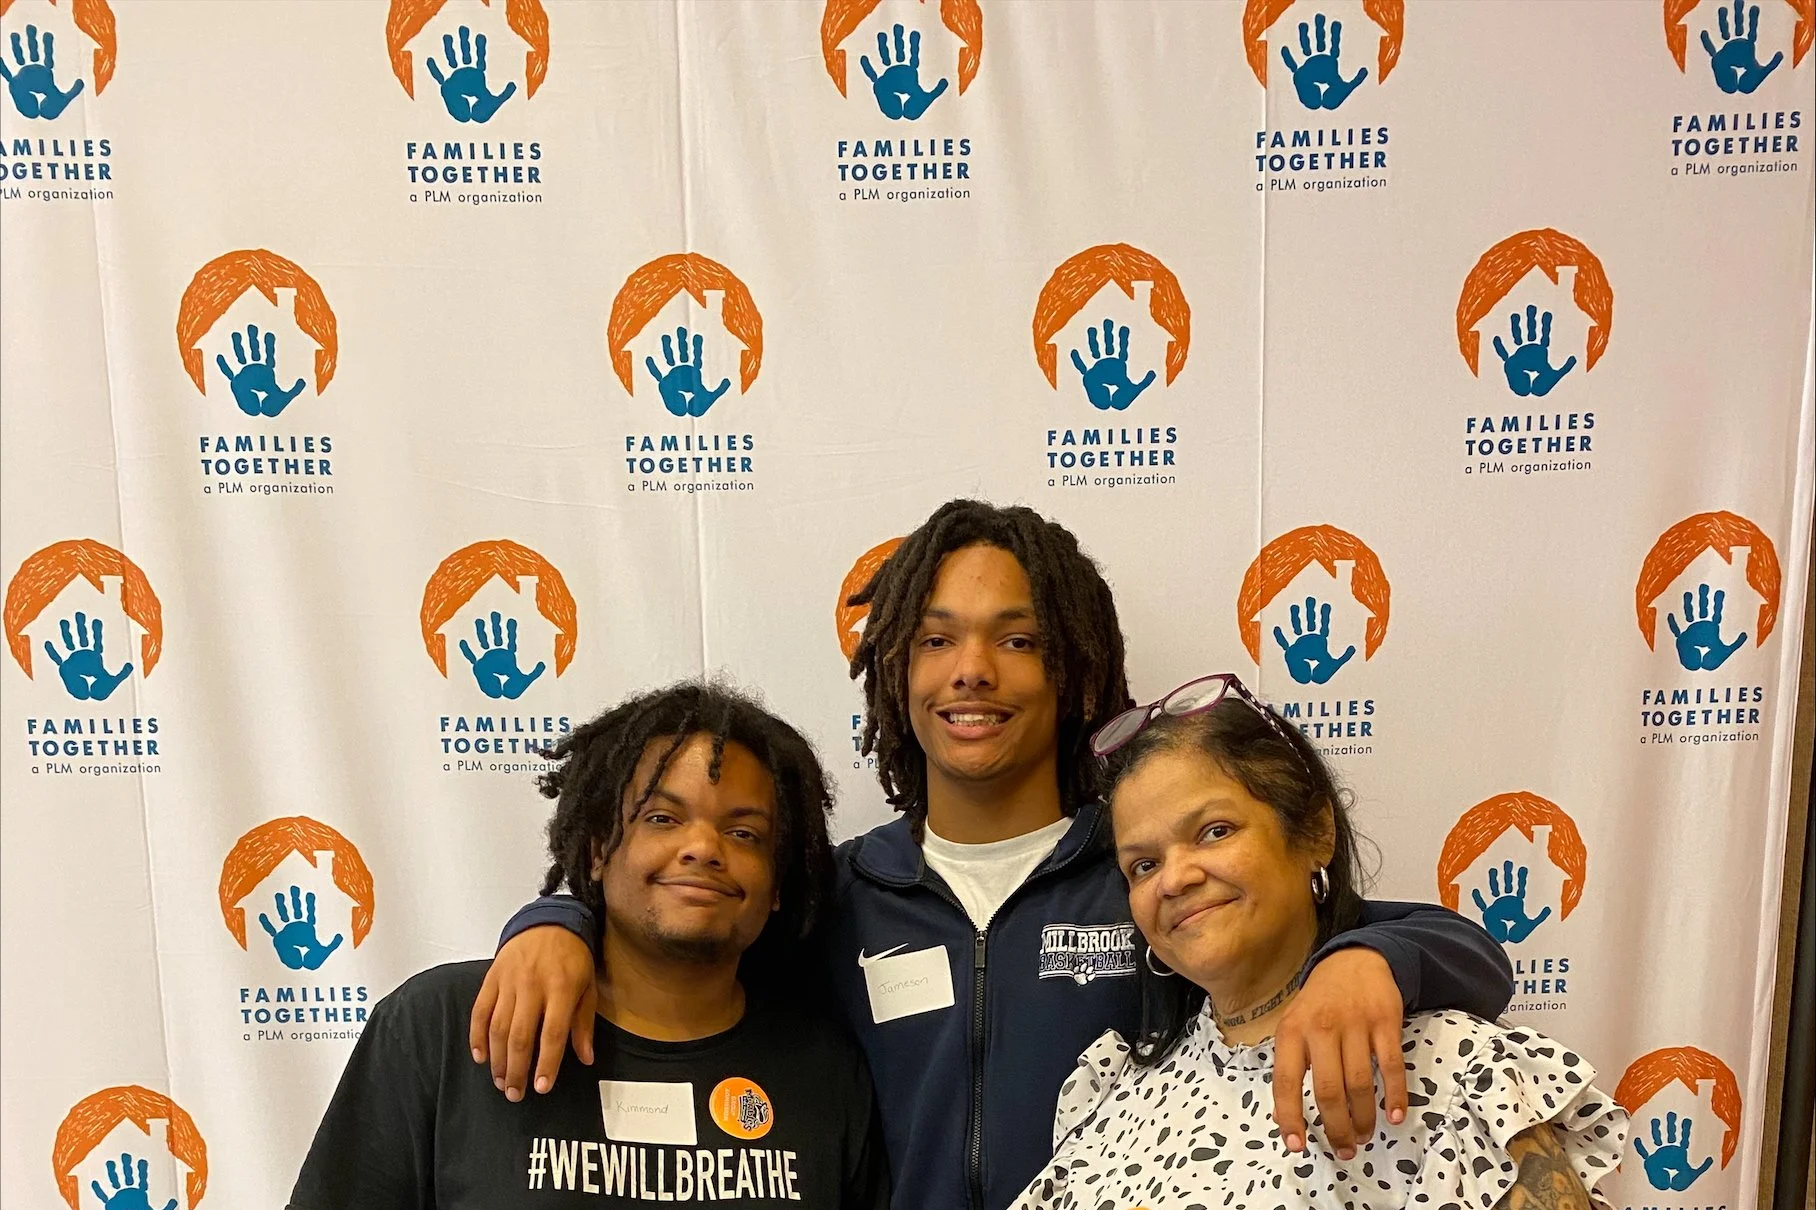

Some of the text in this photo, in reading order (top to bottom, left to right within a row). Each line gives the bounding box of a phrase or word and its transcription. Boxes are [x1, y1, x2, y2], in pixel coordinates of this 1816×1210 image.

[1673, 110, 1801, 133] FAMILIES
[1256, 127, 1389, 149] FAMILIES
[1672, 135, 1799, 157] TOGETHER
[0, 139, 111, 157] AMILIES
[407, 142, 542, 160] FAMILIES
[838, 138, 971, 159] FAMILIES
[1256, 151, 1387, 172] TOGETHER
[1671, 160, 1798, 177] a PLM organization
[0, 162, 112, 181] OGETHER
[408, 165, 542, 184] TOGETHER
[838, 162, 970, 181] TOGETHER
[1256, 176, 1387, 192] a PLM organization
[28, 187, 114, 201] organization
[409, 190, 543, 205] a PLM organization
[839, 187, 970, 203] a PLM organization
[1466, 412, 1595, 434] FAMILIES
[200, 435, 332, 454] FAMILIES
[626, 434, 754, 452] FAMILIES
[1047, 427, 1178, 446] FAMILIES
[1465, 435, 1593, 456] TOGETHER
[201, 457, 332, 476] TOGETHER
[626, 457, 753, 475] TOGETHER
[1047, 449, 1175, 469] TOGETHER
[1465, 459, 1591, 475] a PLM organization
[204, 481, 334, 496] a PLM organization
[627, 479, 754, 493] a PLM organization
[1047, 473, 1176, 488] a PLM organization
[1642, 686, 1763, 705] FAMILIES
[1283, 699, 1375, 718] MILIES
[1641, 708, 1760, 727] TOGETHER
[28, 718, 159, 735] FAMILIES
[440, 716, 570, 733] FAMILIES
[1299, 722, 1373, 739] ETHER
[441, 737, 554, 754] TOGETHE
[1640, 730, 1759, 745] a PLM organization
[28, 739, 160, 757] TOGETHER
[31, 762, 161, 776] a PLM organization
[443, 759, 563, 773] a PLM organizatio
[1516, 958, 1570, 975] LIES
[240, 986, 368, 1003] FAMILIES
[1512, 979, 1567, 995] THER
[241, 1008, 368, 1024] TOGETHER
[243, 1029, 361, 1042] a PLM organizatio
[528, 1137, 802, 1201] #WEWILLBREATHE
